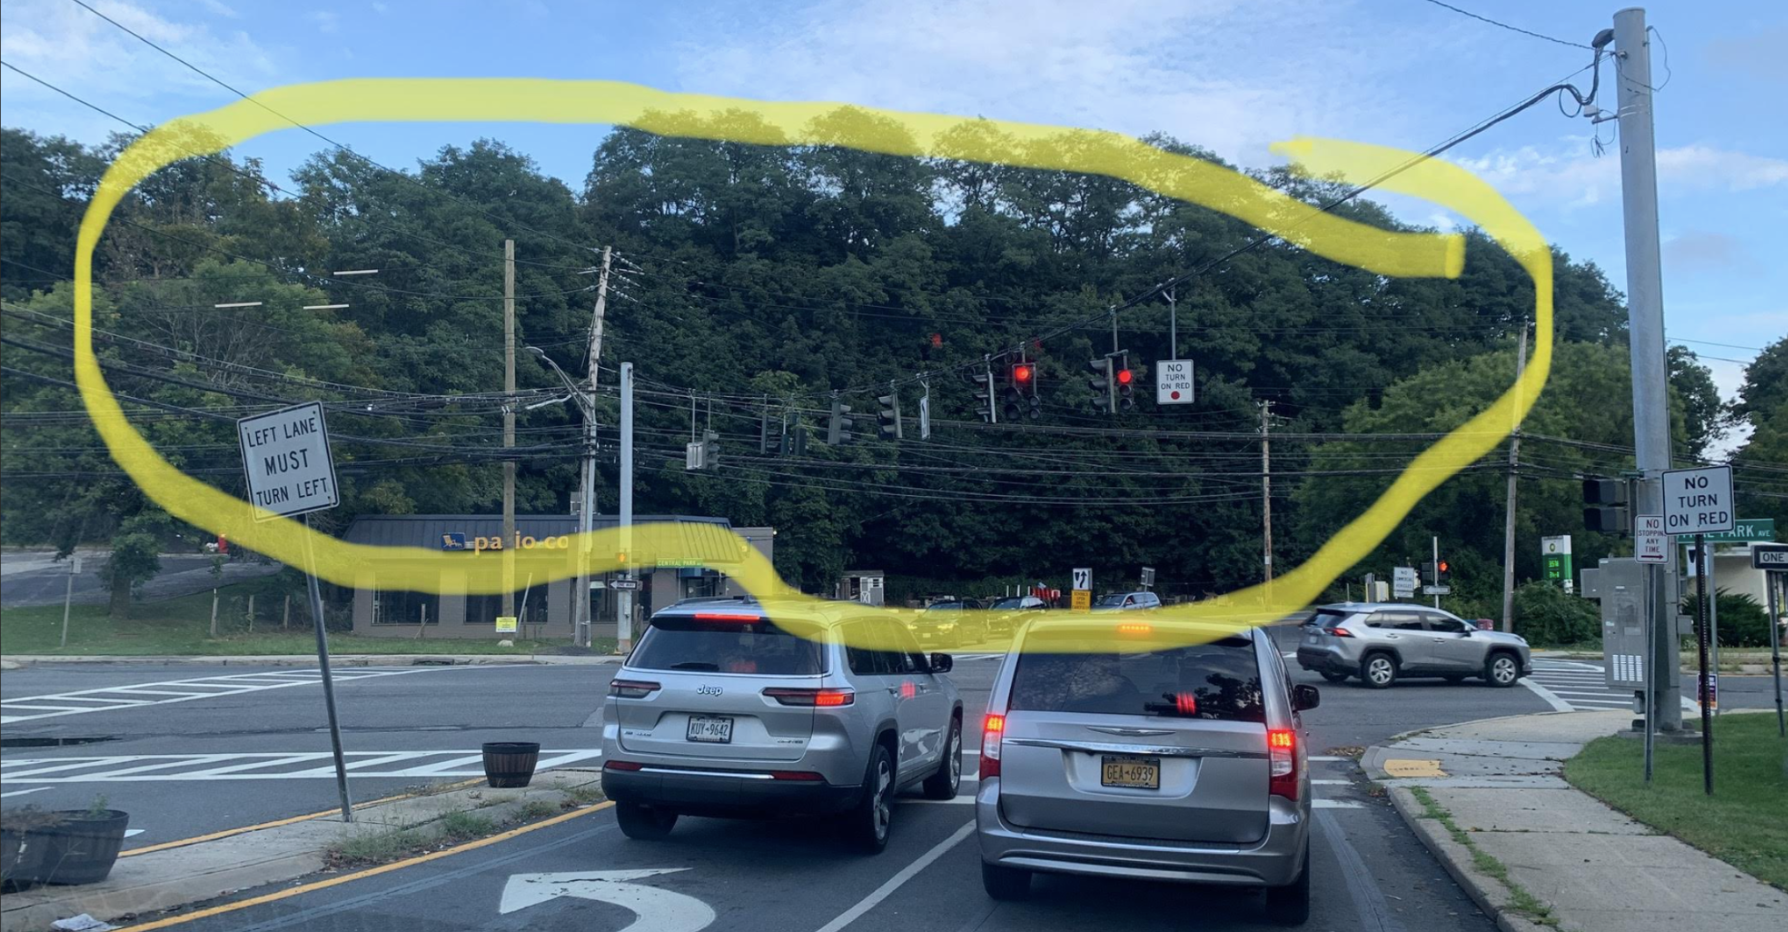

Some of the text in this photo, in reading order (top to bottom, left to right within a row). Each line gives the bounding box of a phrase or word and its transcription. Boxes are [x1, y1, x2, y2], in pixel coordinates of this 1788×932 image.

[1167, 363, 1183, 372] NO
[247, 417, 317, 448] LEFT LANE
[264, 448, 308, 476] MUST
[1684, 476, 1709, 490] NO
[256, 477, 327, 507] TURN LEFT
[1678, 494, 1718, 508] TURN
[1646, 519, 1659, 529] NO
[1669, 511, 1728, 528] ON RED
[1758, 529, 1771, 537] AVE
[1762, 552, 1785, 562] ONE
[696, 684, 724, 697] Jeep
